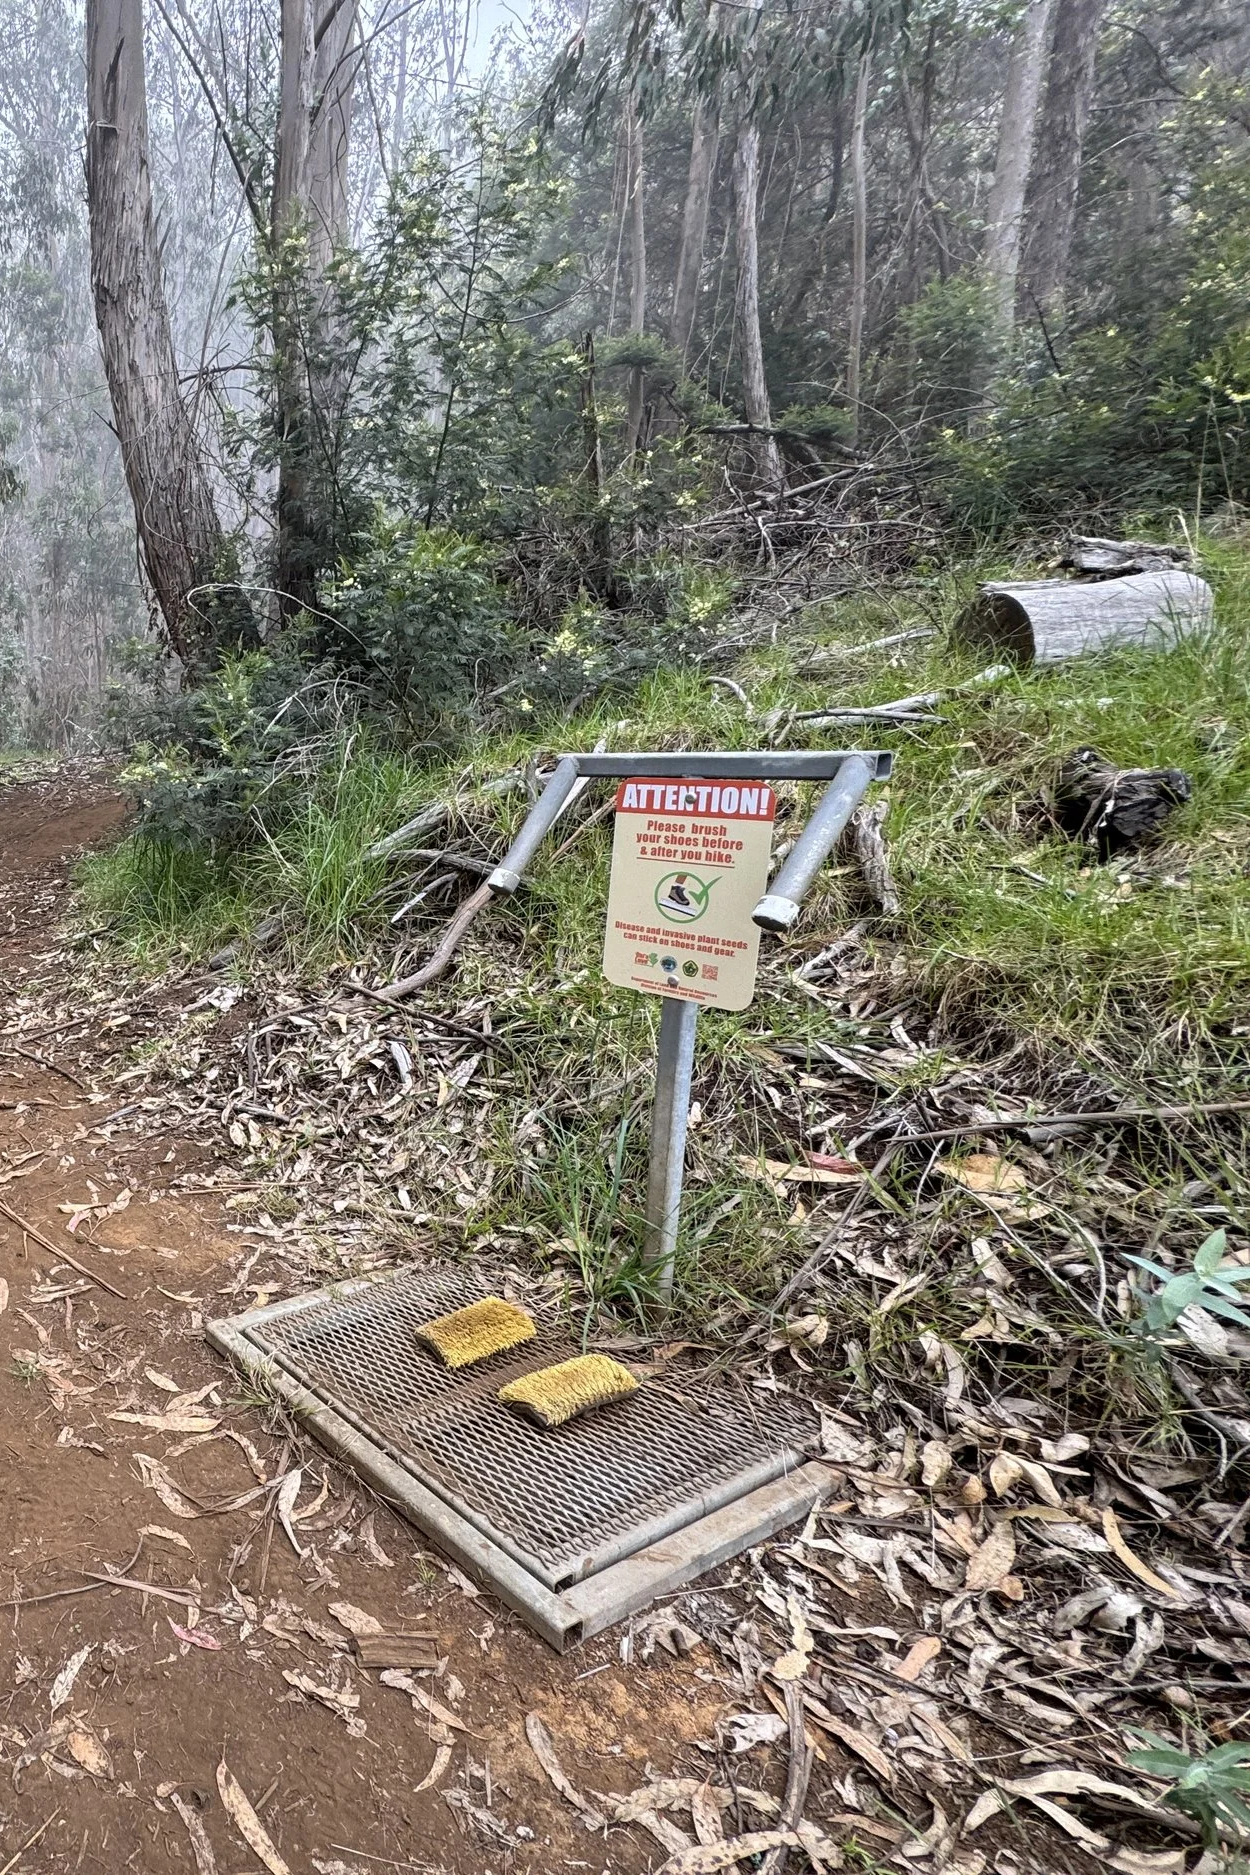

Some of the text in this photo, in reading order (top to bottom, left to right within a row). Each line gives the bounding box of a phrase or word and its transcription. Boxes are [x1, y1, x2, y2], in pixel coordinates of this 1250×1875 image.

[622, 783, 770, 815] ATTENTION!
[647, 820, 727, 836] Please brush
[636, 832, 743, 850] your shoes before
[640, 846, 735, 864] & after you hike.
[615, 920, 748, 950] Disease and invasive plant seeds
[639, 934, 658, 944] stick
[671, 940, 695, 950] shoes
[697, 944, 712, 953] and
[714, 948, 736, 957] gear.
